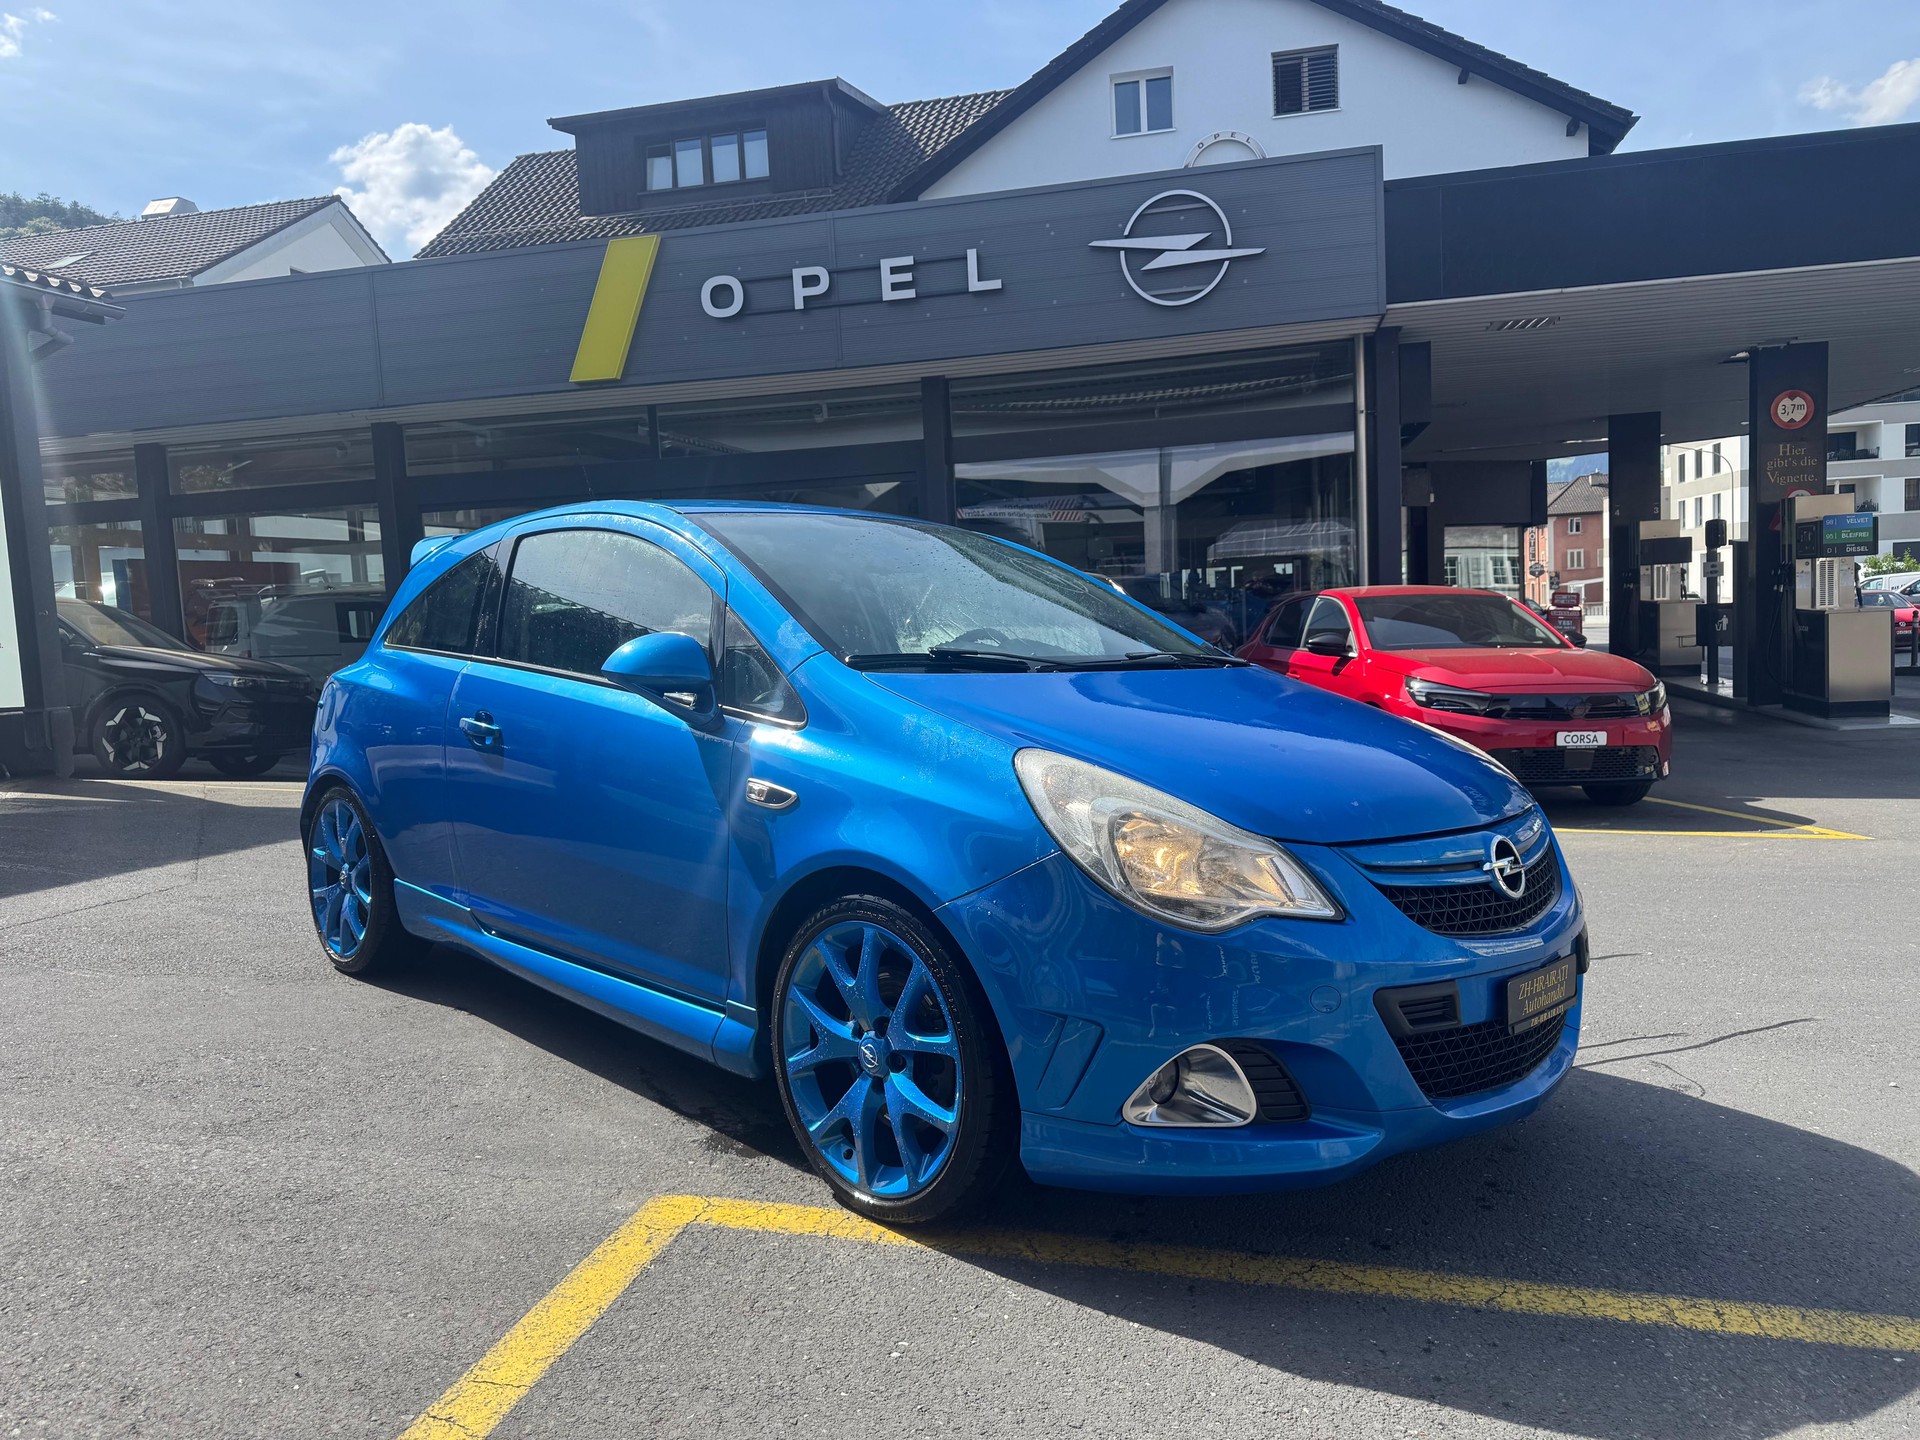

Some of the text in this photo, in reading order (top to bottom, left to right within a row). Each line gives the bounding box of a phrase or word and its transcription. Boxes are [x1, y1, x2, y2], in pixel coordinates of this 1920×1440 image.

[1197, 131, 1252, 149] OPEL
[700, 248, 1003, 319] OPEL
[1778, 443, 1807, 457] Hier
[1766, 455, 1818, 471] gibt's die
[1766, 471, 1818, 486] Vignette.
[1841, 531, 1870, 539] BLEIFREI
[1563, 734, 1599, 744] CORSA
[1522, 981, 1565, 1015] Autohandel
